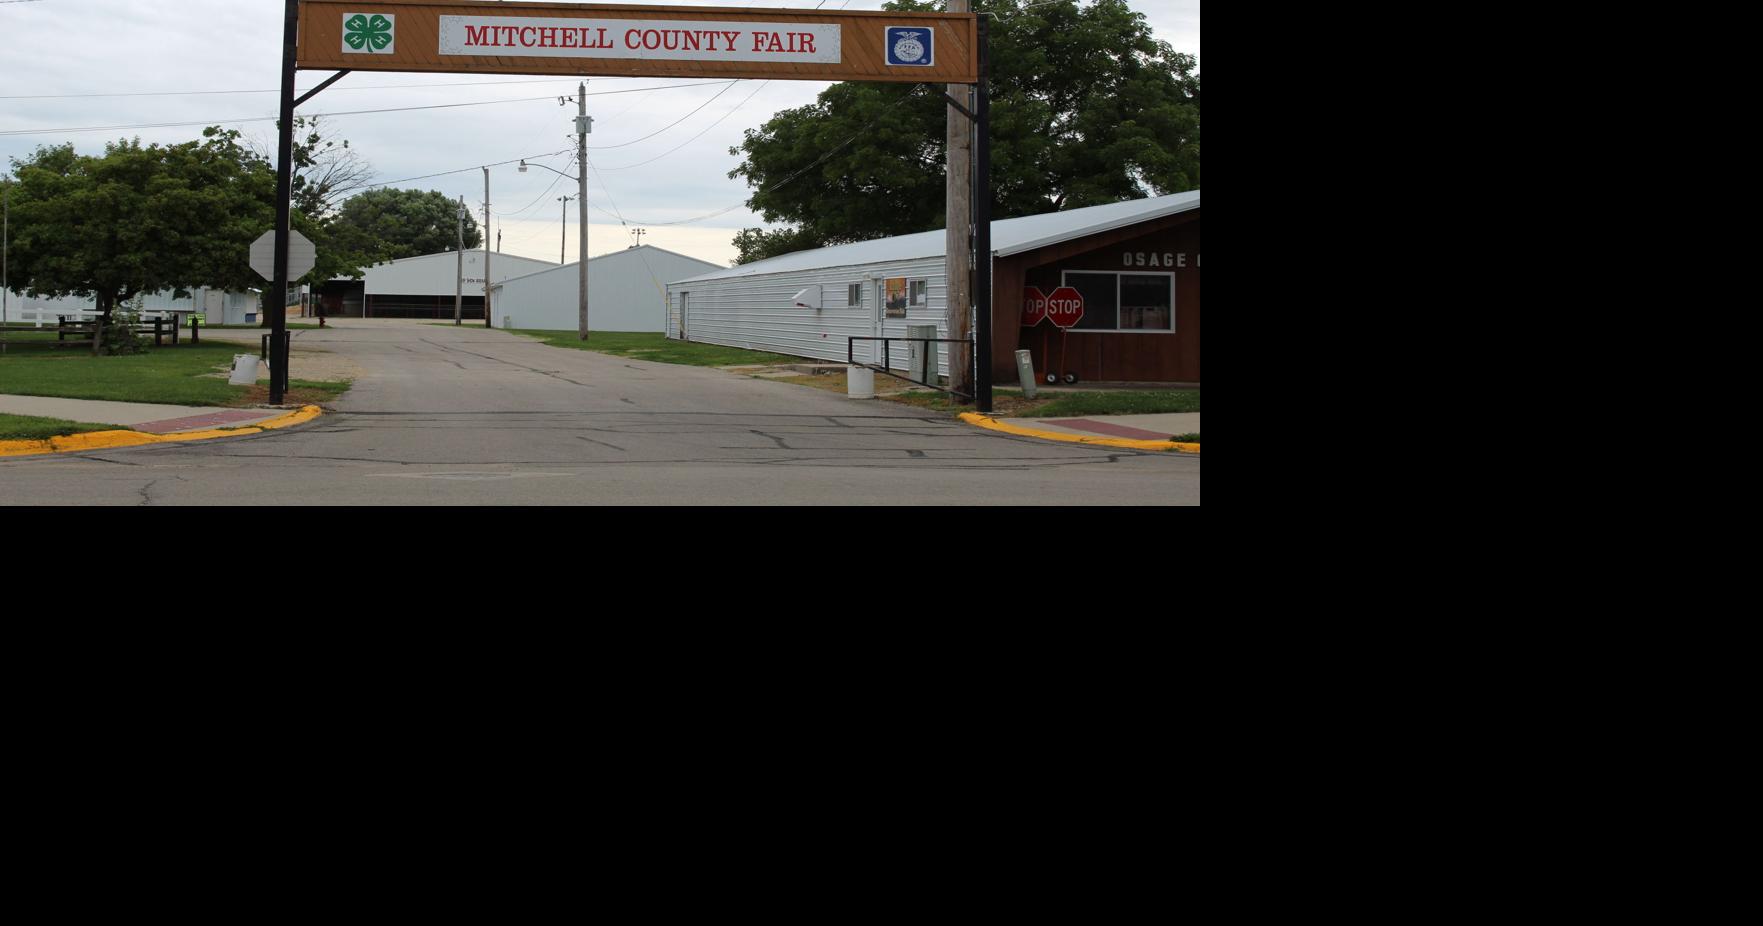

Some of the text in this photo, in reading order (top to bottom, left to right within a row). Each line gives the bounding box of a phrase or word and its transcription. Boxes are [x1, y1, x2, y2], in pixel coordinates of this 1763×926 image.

[464, 25, 817, 53] MITCHELL COUNTY FAIR
[1123, 251, 1186, 267] OSAGE
[1025, 299, 1045, 314] OP
[1048, 299, 1081, 314] STOP
